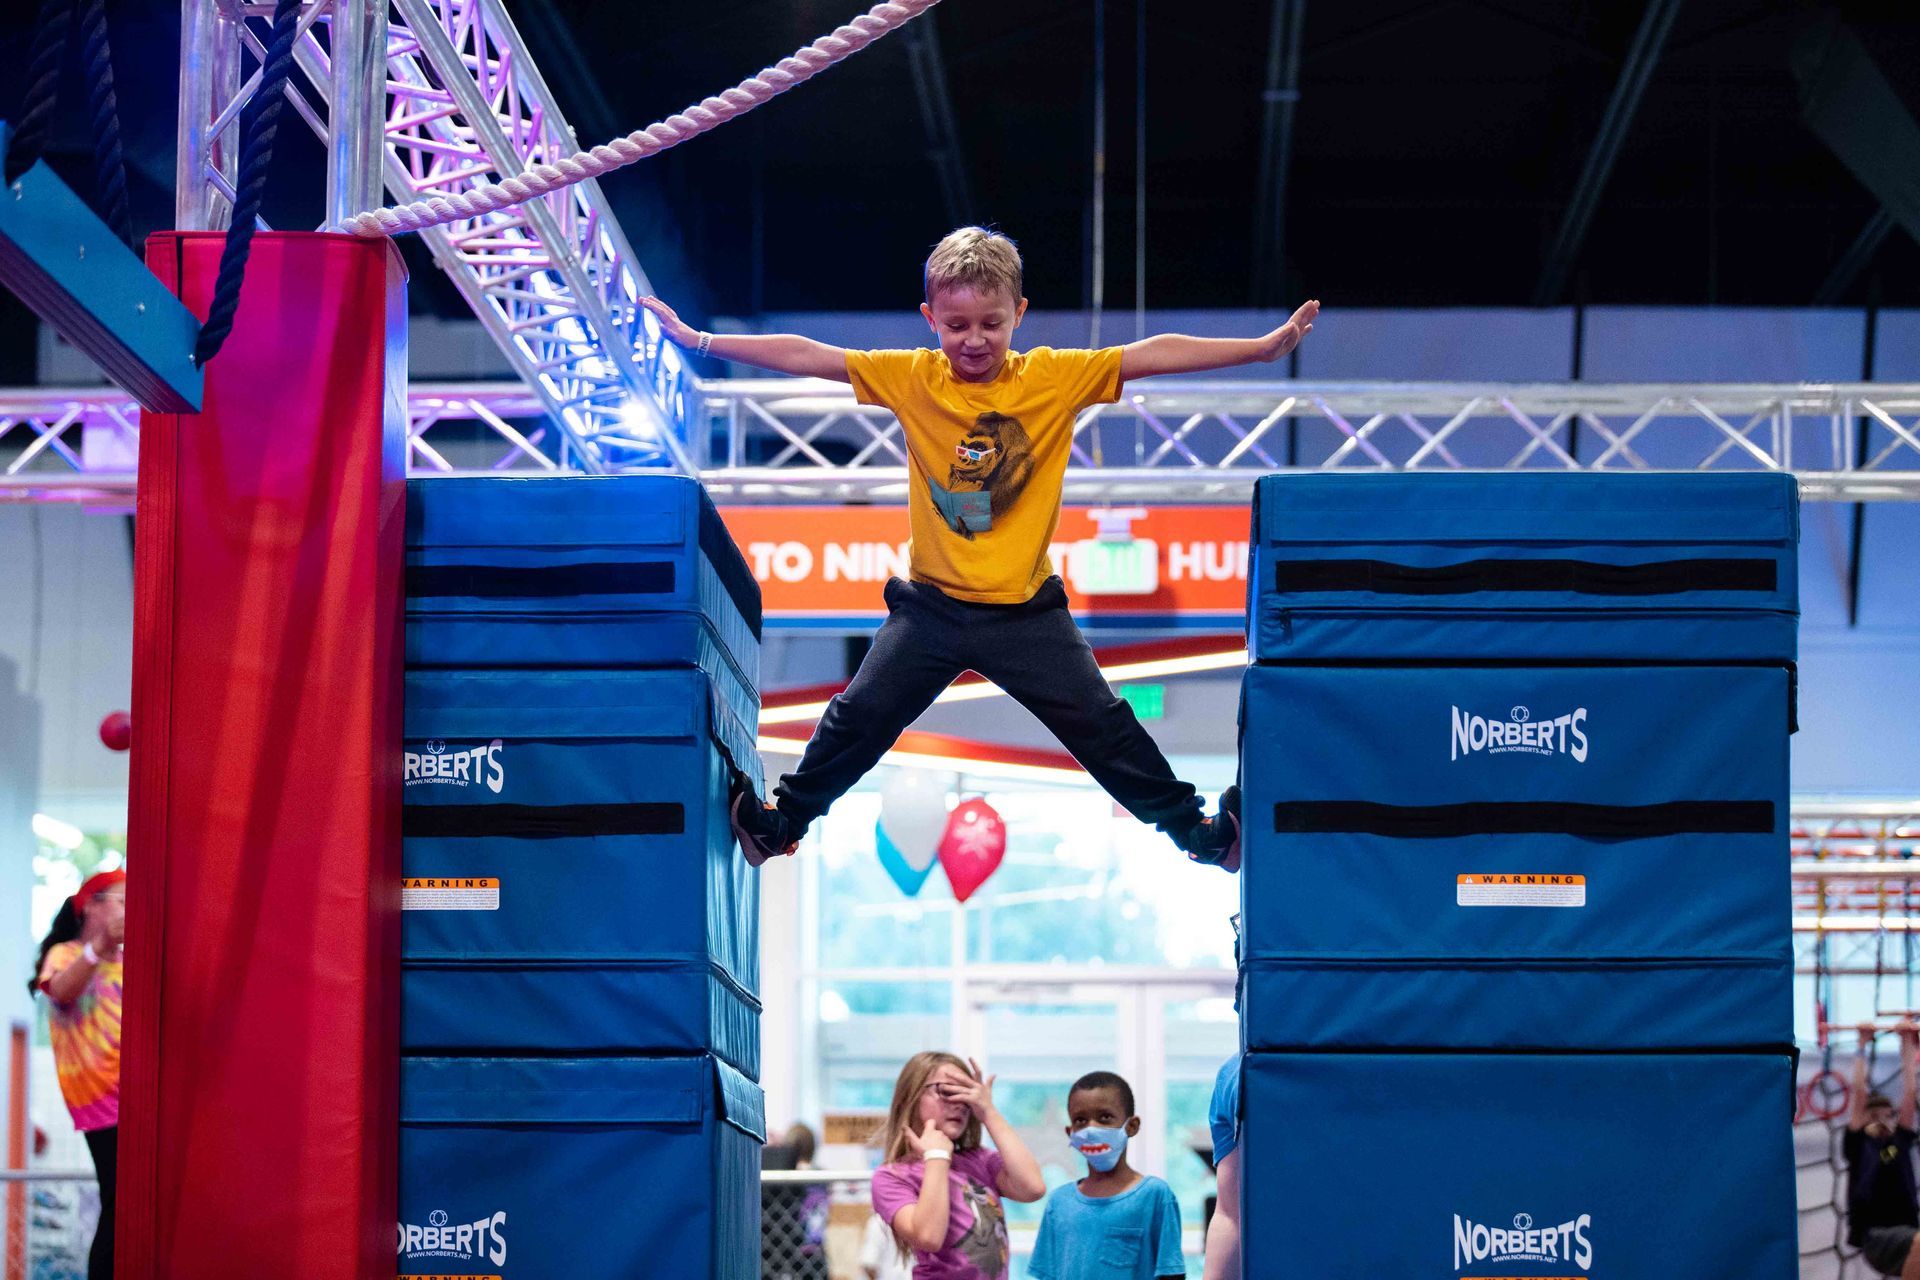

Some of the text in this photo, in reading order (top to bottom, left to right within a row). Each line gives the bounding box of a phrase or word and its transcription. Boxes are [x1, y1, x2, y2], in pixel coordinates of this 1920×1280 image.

[748, 540, 814, 583] TO
[822, 541, 910, 583] NIN
[1451, 704, 1588, 763] NORBERTS
[1488, 746, 1553, 756] WWW.NORBERTS.NET
[403, 738, 504, 794] RBERTS
[405, 777, 470, 787] WWW.NORBERTS.NET
[1482, 875, 1574, 884] WARNING
[1453, 1212, 1593, 1271] NORBERTS
[406, 1250, 472, 1260] WWW.NORBERTS.NET
[1491, 1253, 1558, 1264] WWW.NORBERTS.NET
